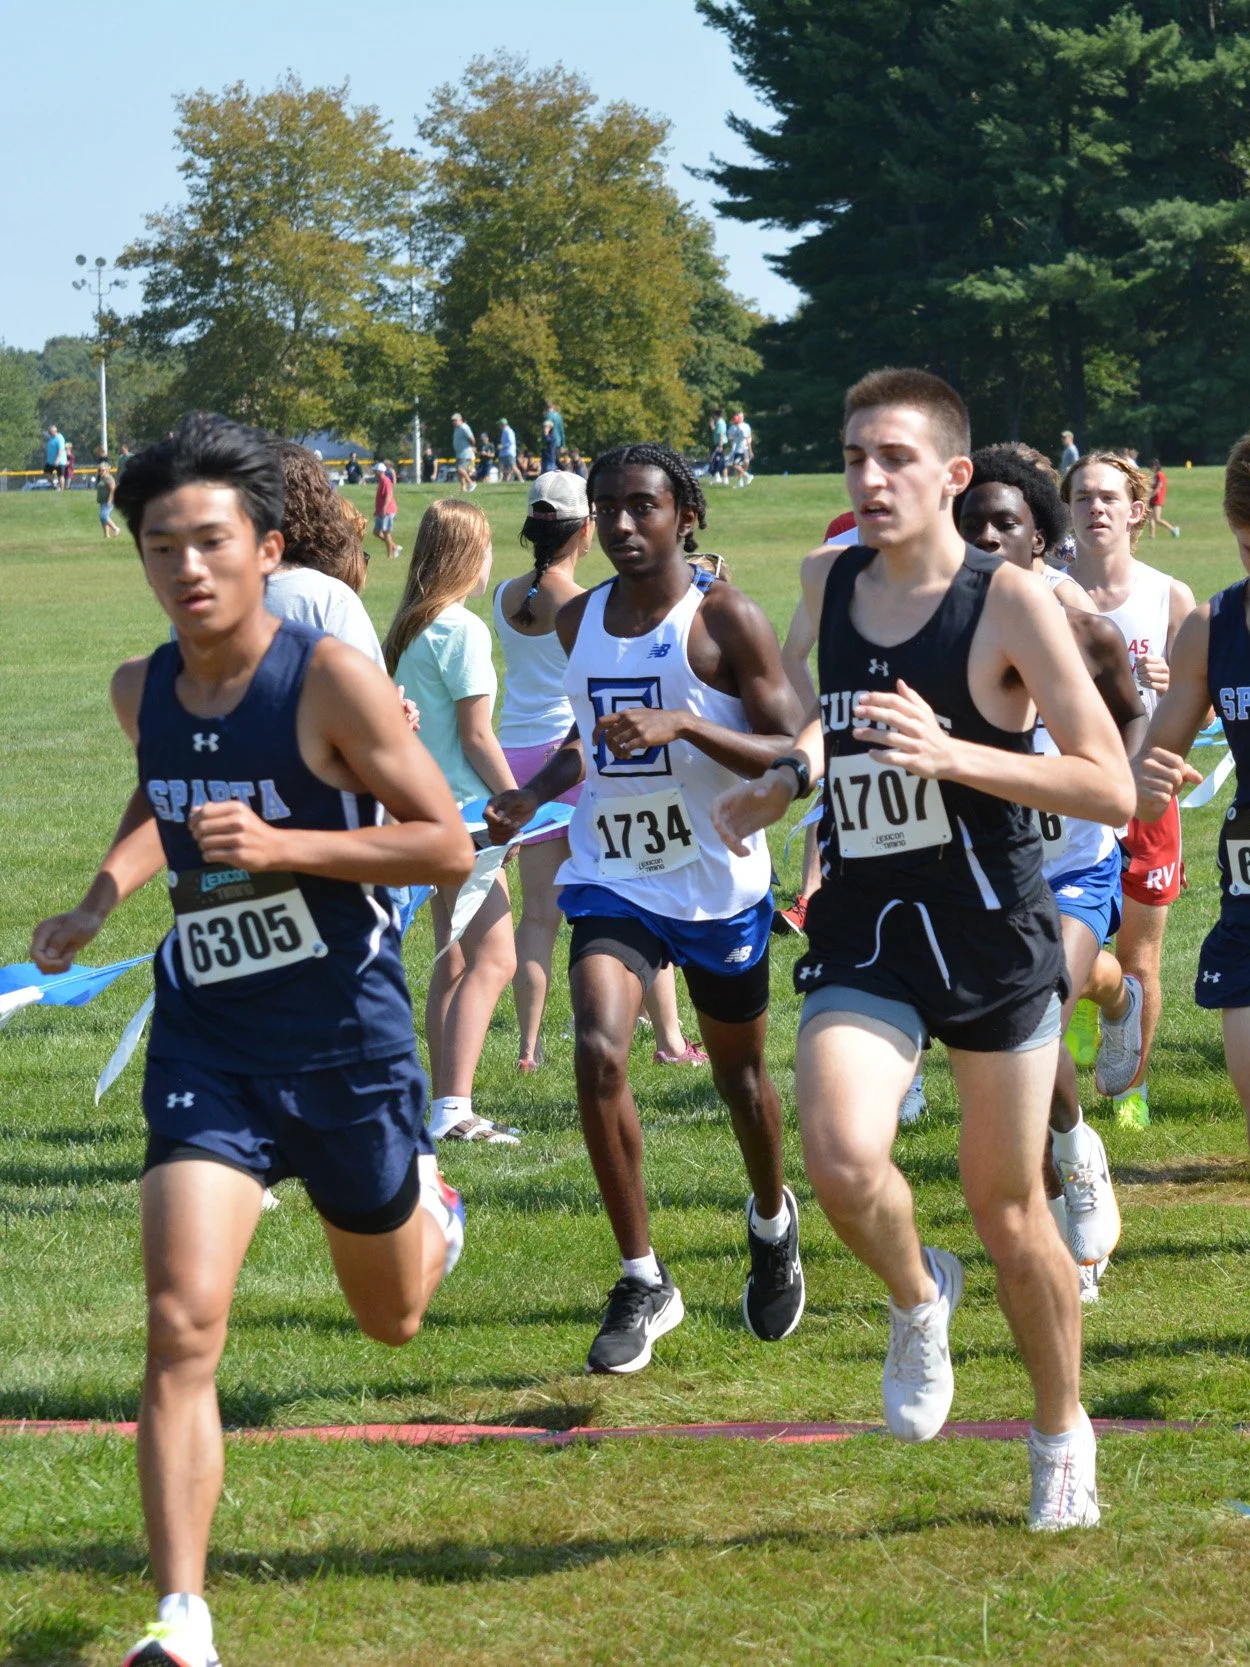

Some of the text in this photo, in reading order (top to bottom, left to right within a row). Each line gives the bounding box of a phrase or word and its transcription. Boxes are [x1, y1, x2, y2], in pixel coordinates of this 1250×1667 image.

[147, 779, 292, 823] SPARTA
[833, 770, 929, 831] 1707
[597, 804, 692, 859] 1734
[1146, 863, 1175, 890] RV
[187, 903, 302, 973] 6305
